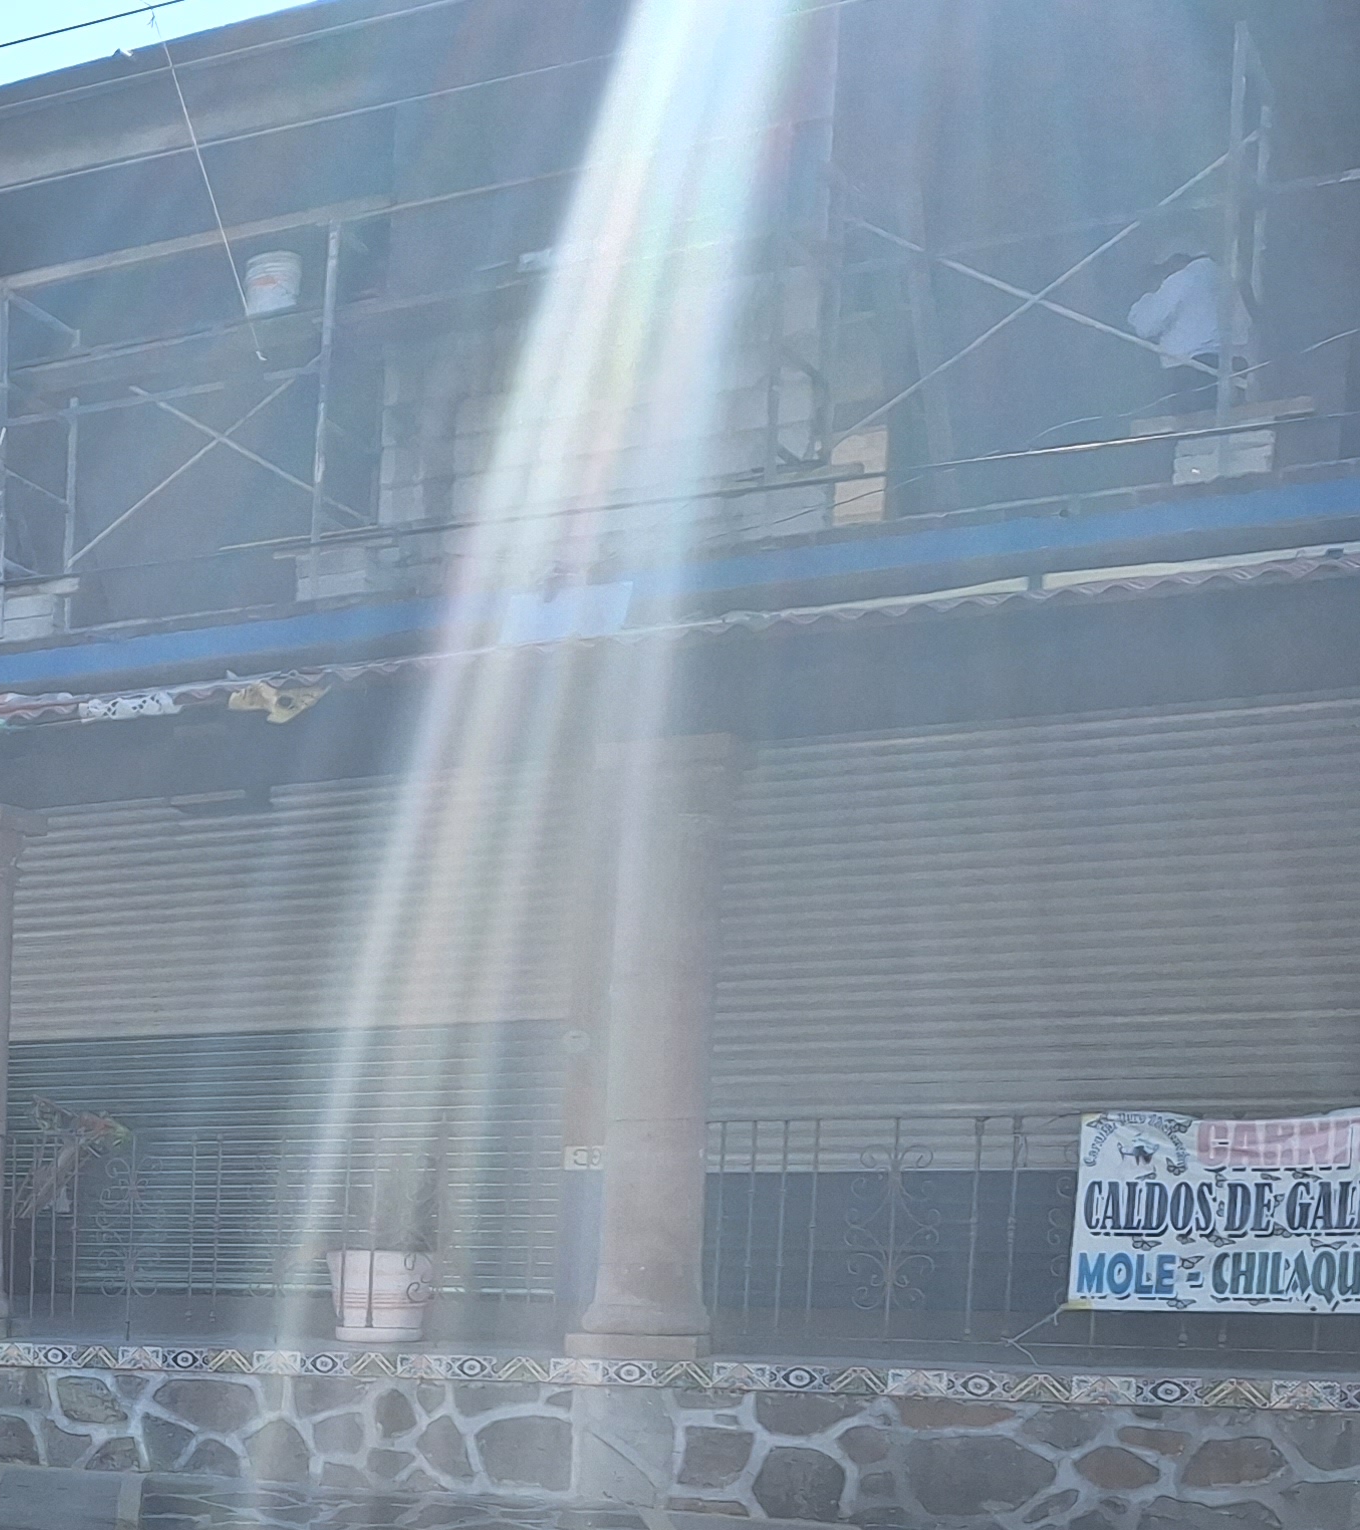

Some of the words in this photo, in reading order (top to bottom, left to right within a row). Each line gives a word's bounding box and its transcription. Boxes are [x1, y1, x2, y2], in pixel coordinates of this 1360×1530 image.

[1197, 1118, 1360, 1167] CARNI
[1083, 1180, 1215, 1231] CALDOS
[1224, 1181, 1274, 1232] DE
[1285, 1180, 1360, 1231] GAL
[1077, 1251, 1177, 1295] MOLE
